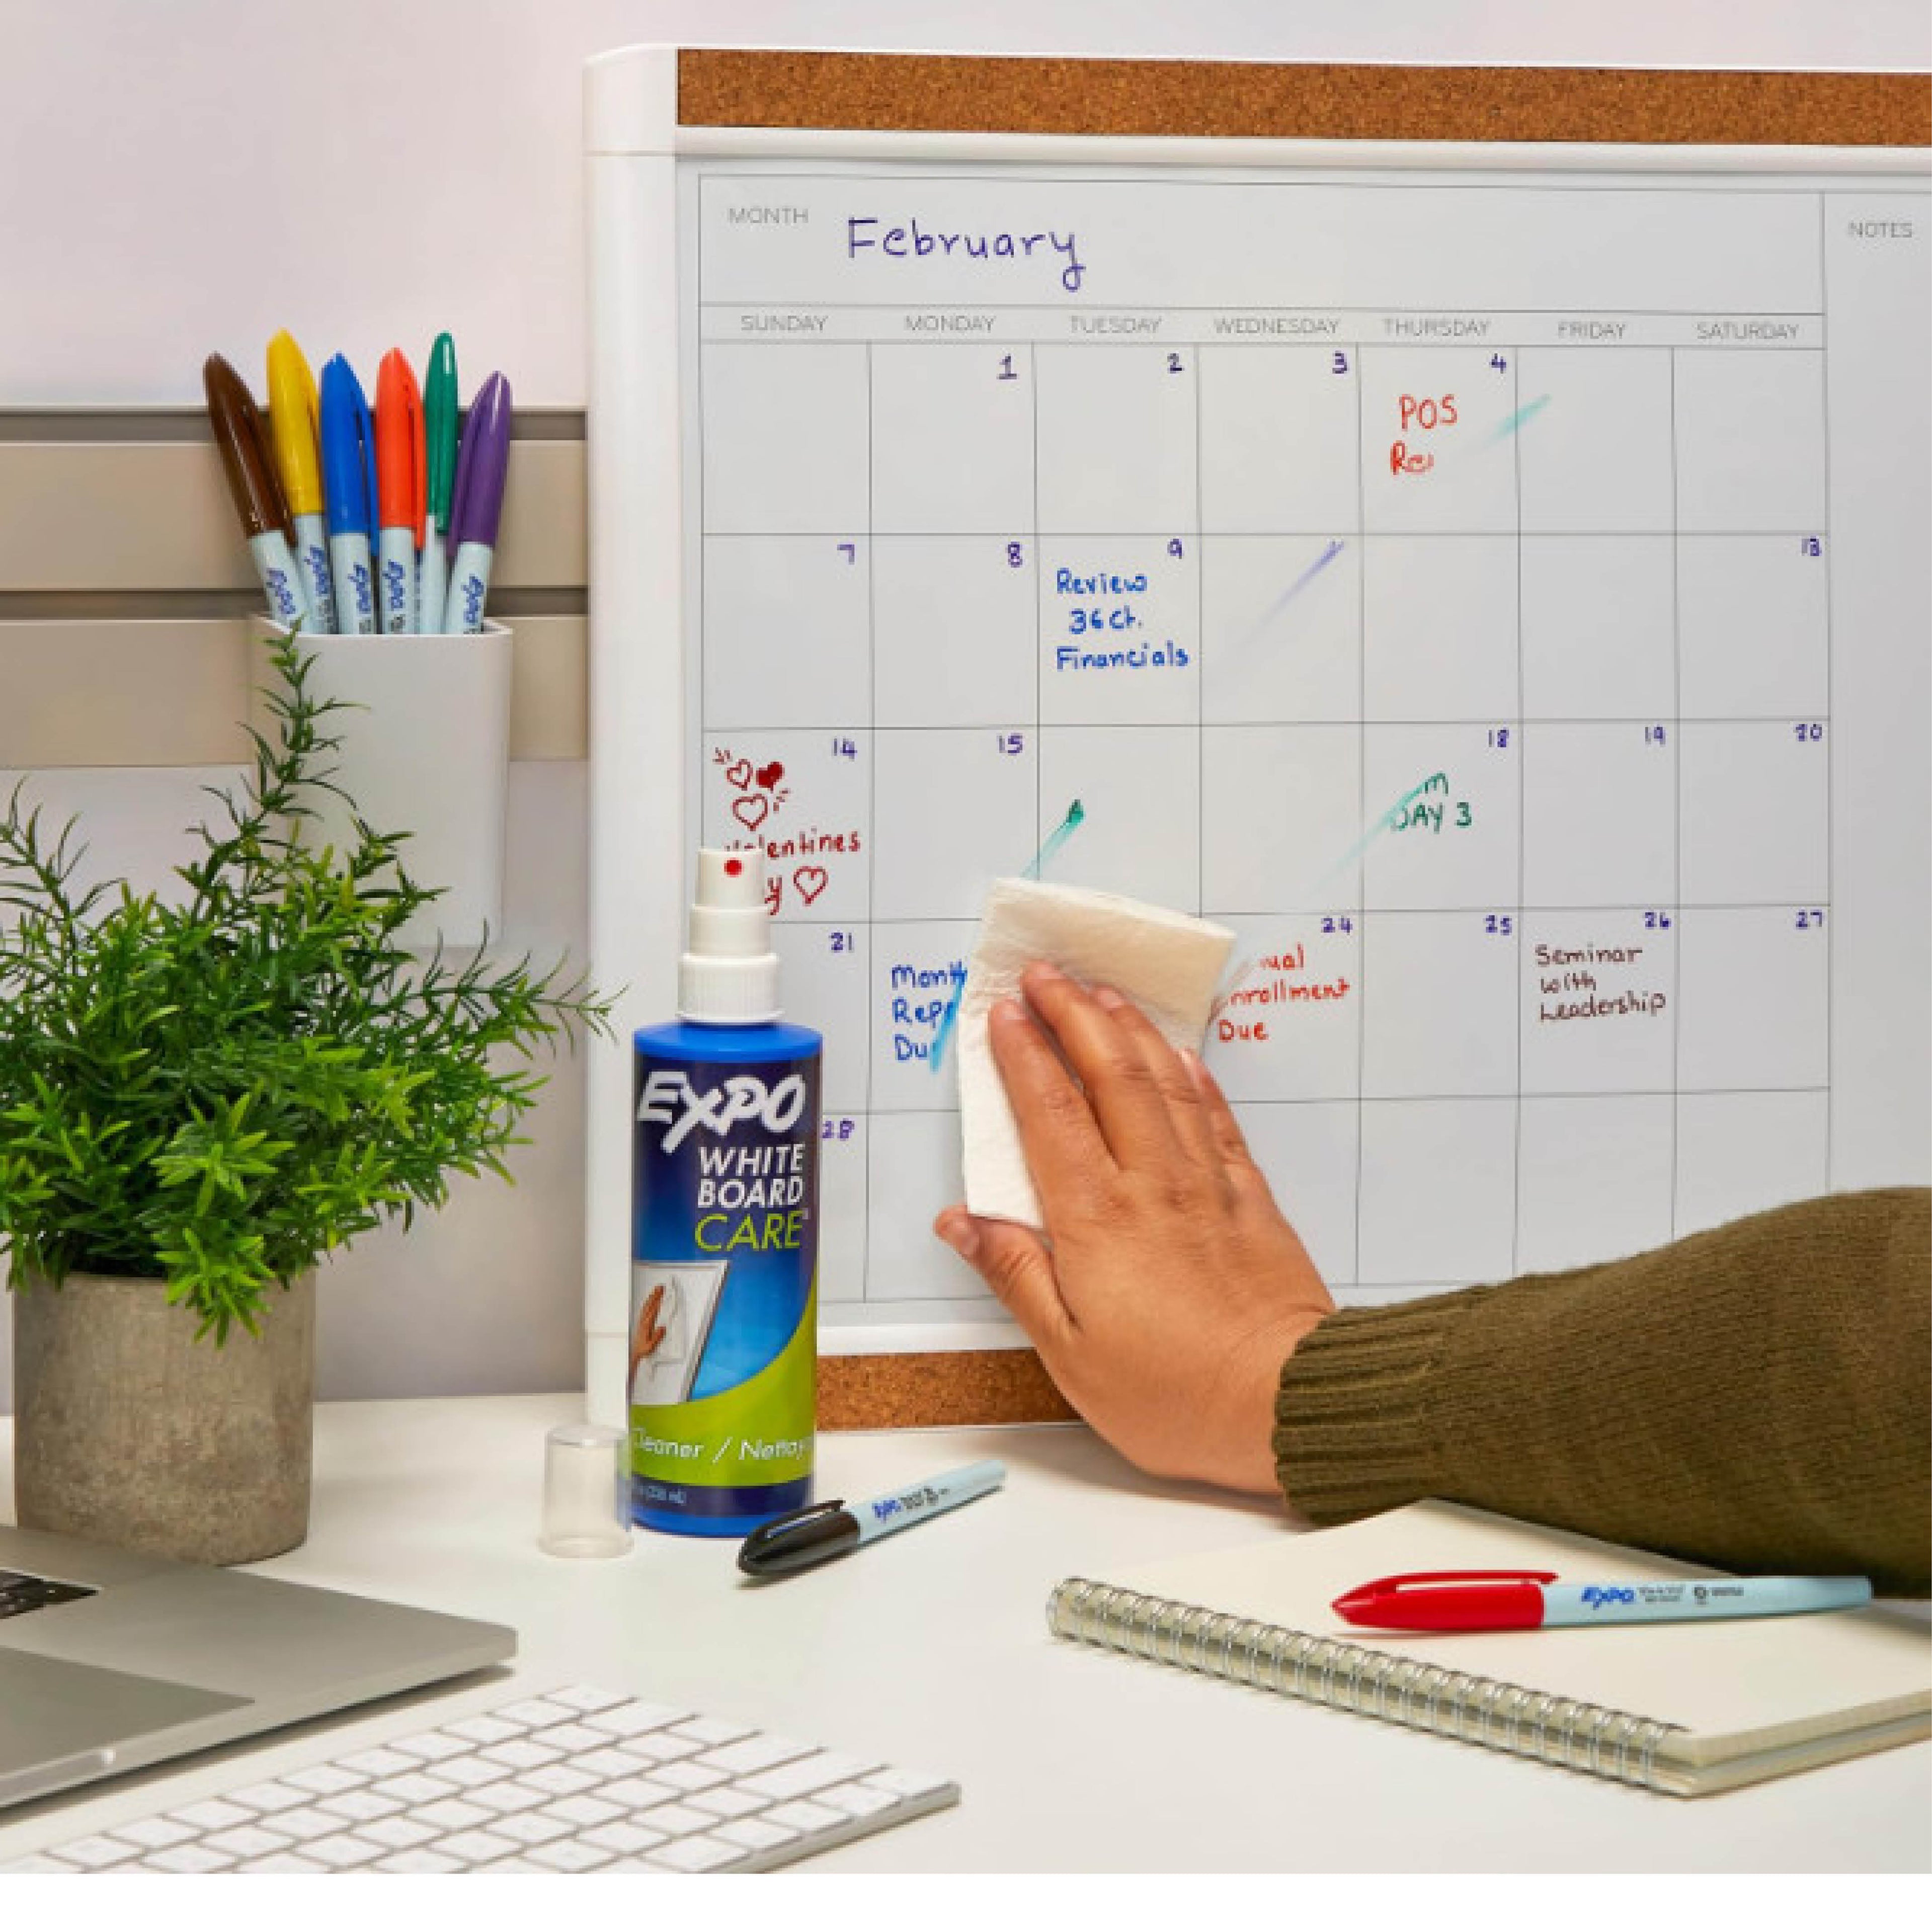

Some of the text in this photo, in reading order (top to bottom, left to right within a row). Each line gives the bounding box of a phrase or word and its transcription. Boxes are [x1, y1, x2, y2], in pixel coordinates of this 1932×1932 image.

[728, 207, 809, 224] MONTH
[1848, 221, 1913, 238] NOTES
[847, 216, 1087, 292] February
[740, 314, 829, 333] SUNDAY
[905, 315, 996, 333] MONDAY
[1070, 315, 1162, 334] TUESDAY
[1213, 317, 1341, 334] WEDNESDAY
[1384, 318, 1491, 337] THURSDAY
[1557, 321, 1627, 340] FRIDAY
[1696, 321, 1800, 340] SATURDAY
[998, 355, 1018, 380] 1
[1167, 352, 1185, 374] 2
[1332, 350, 1349, 374] 3
[1489, 353, 1507, 373] 4
[1398, 393, 1458, 432] POS
[836, 543, 856, 565] 7
[1007, 541, 1023, 568] 8
[1167, 538, 1183, 559] 9
[1056, 568, 1148, 595] Review
[1056, 640, 1189, 671] Financials
[997, 733, 1023, 755] 15
[1488, 728, 1510, 748] 18
[1644, 726, 1666, 745] 19
[833, 737, 857, 759] 14
[1455, 801, 1472, 829] 3
[1320, 916, 1353, 935] 24
[1485, 914, 1512, 934] 25
[1644, 911, 1672, 930] 26
[1795, 910, 1823, 930] 27
[829, 932, 854, 953] 21
[1535, 941, 1643, 967] Seminar
[1541, 970, 1596, 994] with
[1541, 990, 1666, 1024] Leadership
[1218, 1018, 1270, 1043] Due
[638, 1071, 805, 1155] EXPO
[698, 1144, 805, 1176] WHITE
[698, 1176, 805, 1208] BOARD
[695, 1210, 803, 1251] CARE
